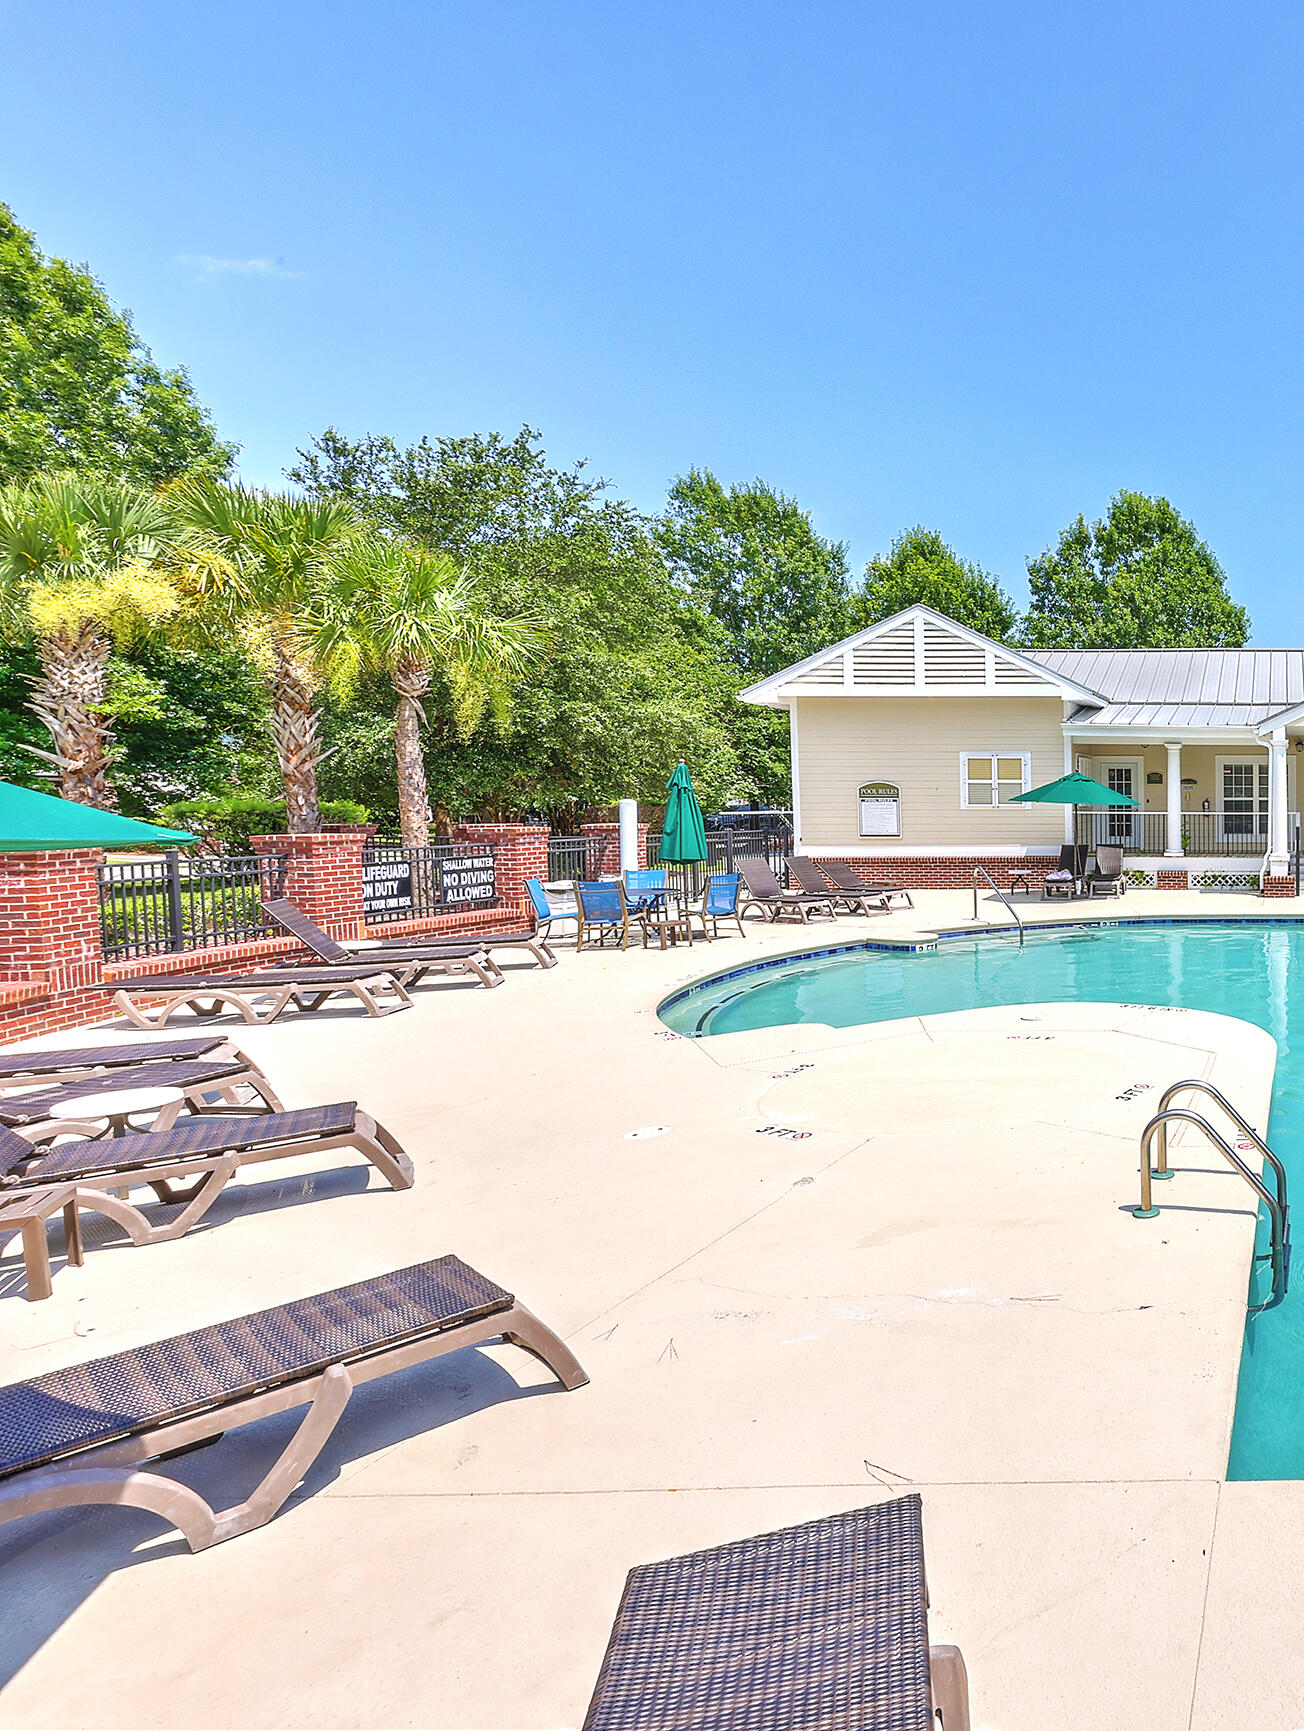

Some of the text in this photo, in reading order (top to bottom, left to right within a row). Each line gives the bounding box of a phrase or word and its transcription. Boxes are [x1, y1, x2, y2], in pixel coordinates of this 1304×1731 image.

[362, 863, 410, 881] LIFEGUARD
[442, 857, 494, 871] SHALLOW WATER
[443, 870, 495, 887] NO DIVING
[375, 880, 399, 896] DUTY
[446, 885, 493, 902] ALLOWED
